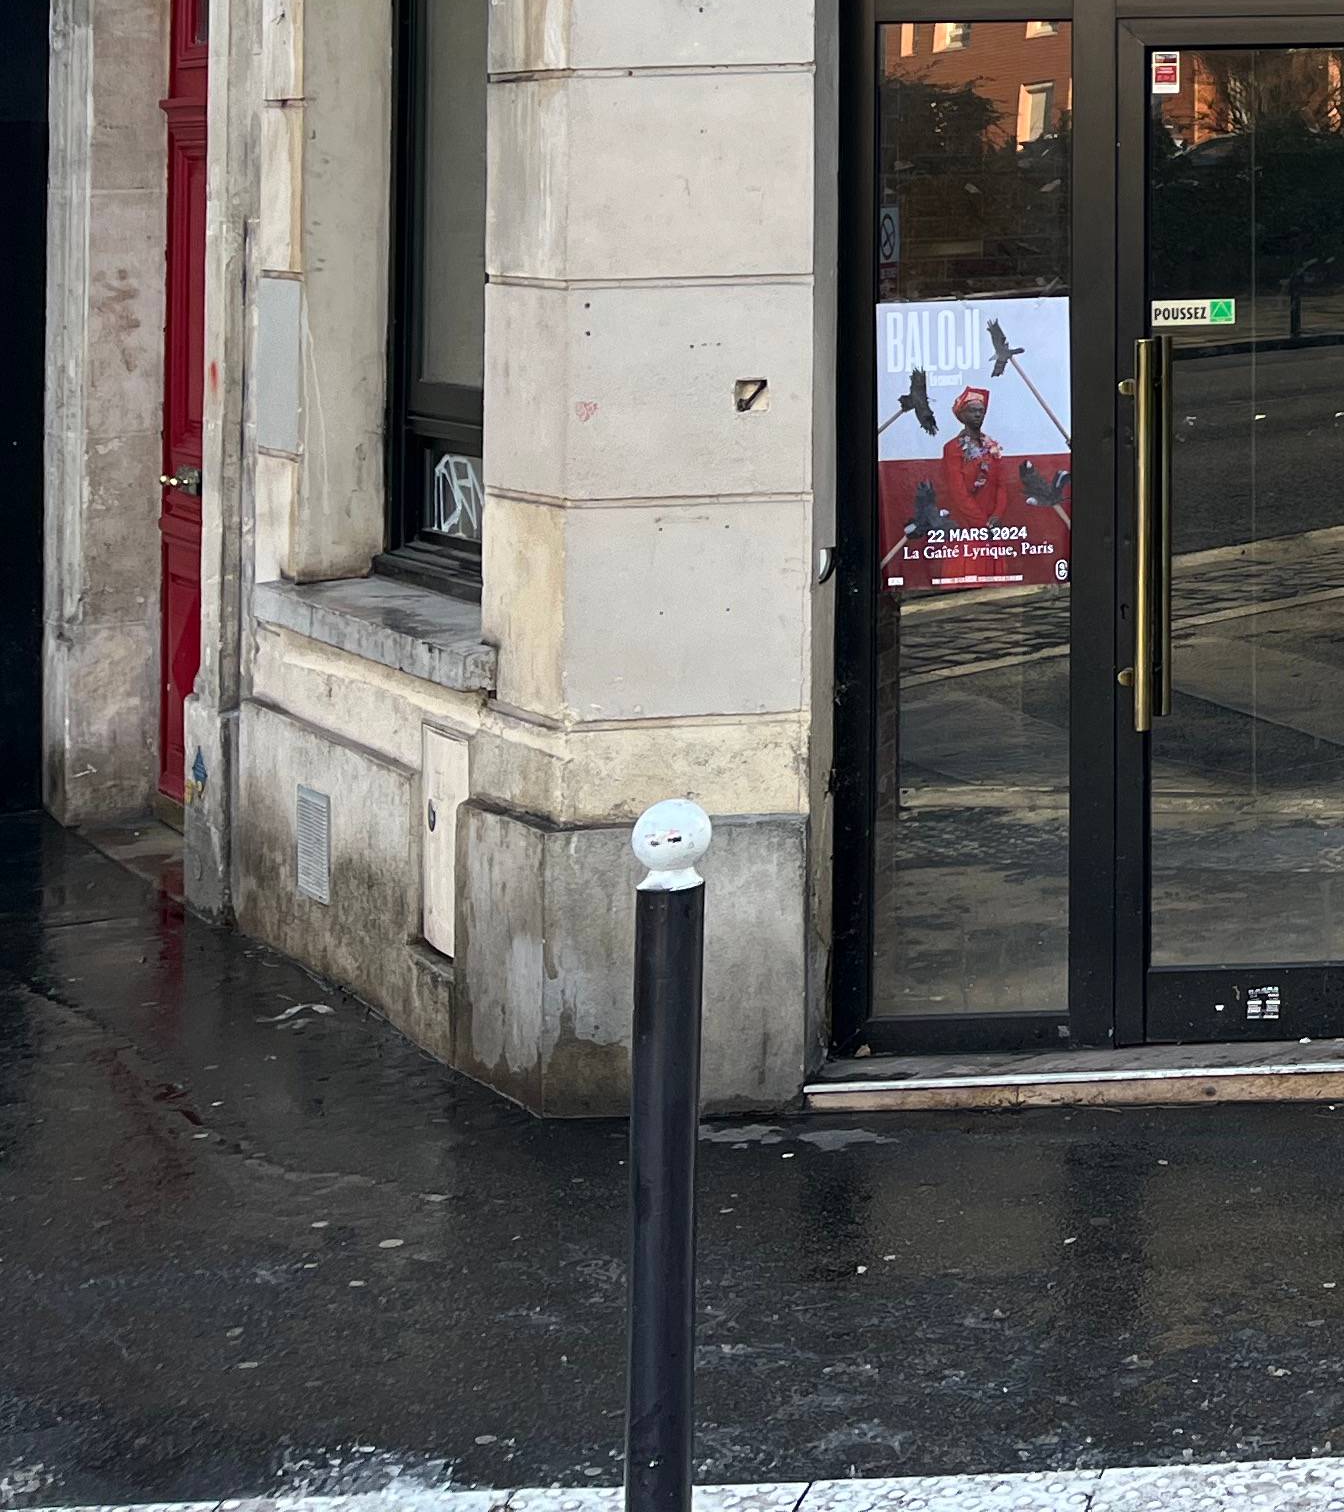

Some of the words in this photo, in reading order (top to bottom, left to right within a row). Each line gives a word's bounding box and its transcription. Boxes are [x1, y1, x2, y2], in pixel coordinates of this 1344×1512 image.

[1154, 307, 1207, 320] POUSSEZ
[885, 309, 981, 373] BALOJI
[927, 530, 945, 544] 22
[949, 528, 989, 542] MARS
[992, 526, 1028, 540] 2024
[903, 548, 920, 560] La
[923, 544, 960, 560] Gaîté
[963, 543, 1018, 561] Lyrique,
[1021, 540, 1054, 555] Paris
